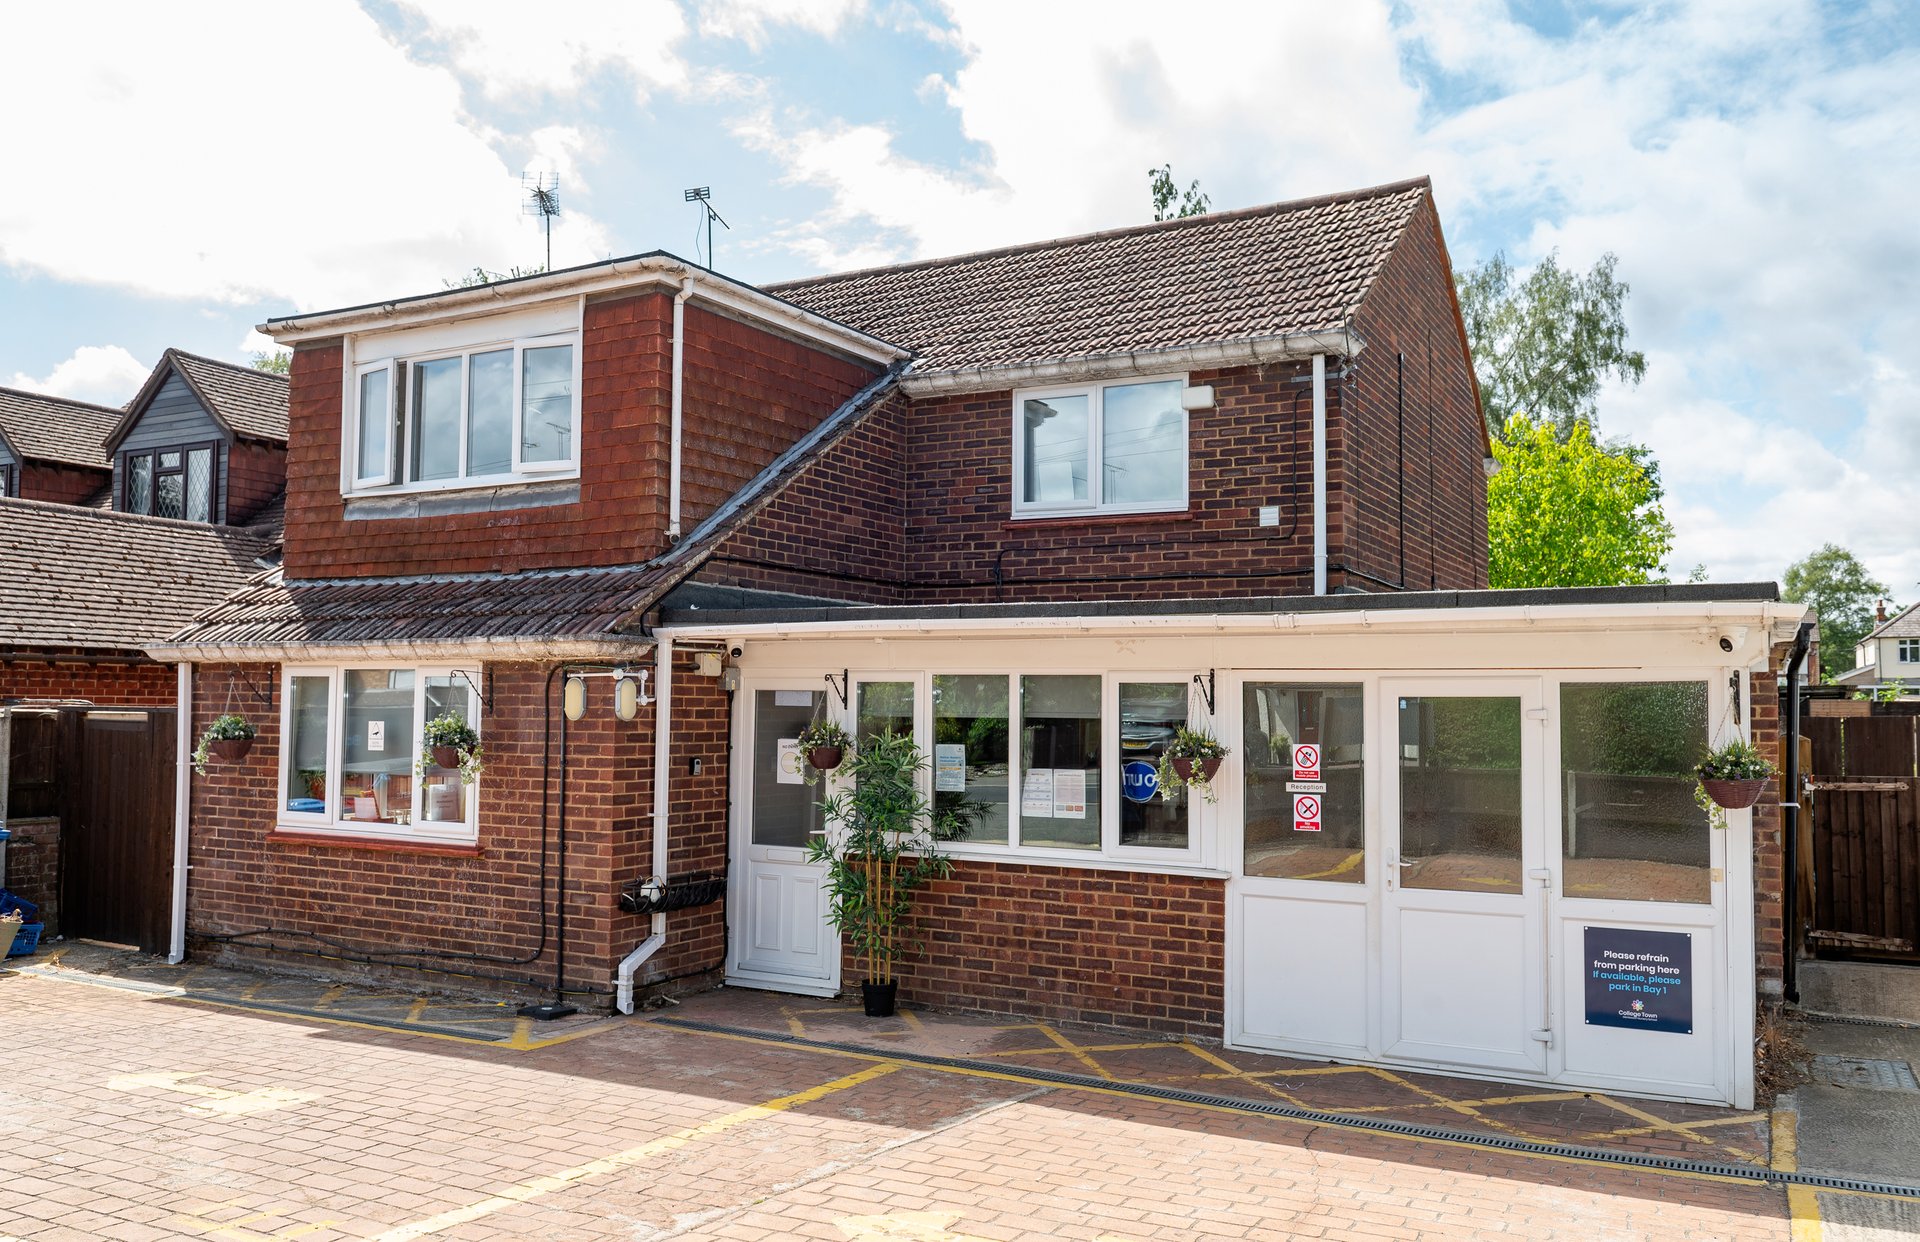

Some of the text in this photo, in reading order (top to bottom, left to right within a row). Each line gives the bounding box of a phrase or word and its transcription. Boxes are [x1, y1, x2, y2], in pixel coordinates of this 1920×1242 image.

[1290, 783, 1324, 791] Reception
[1604, 950, 1670, 962] Please refrain
[1594, 960, 1680, 974] from parking here
[1592, 970, 1681, 985] If available, please
[1608, 982, 1667, 996] park in Bay 1
[1618, 1009, 1642, 1017] College
